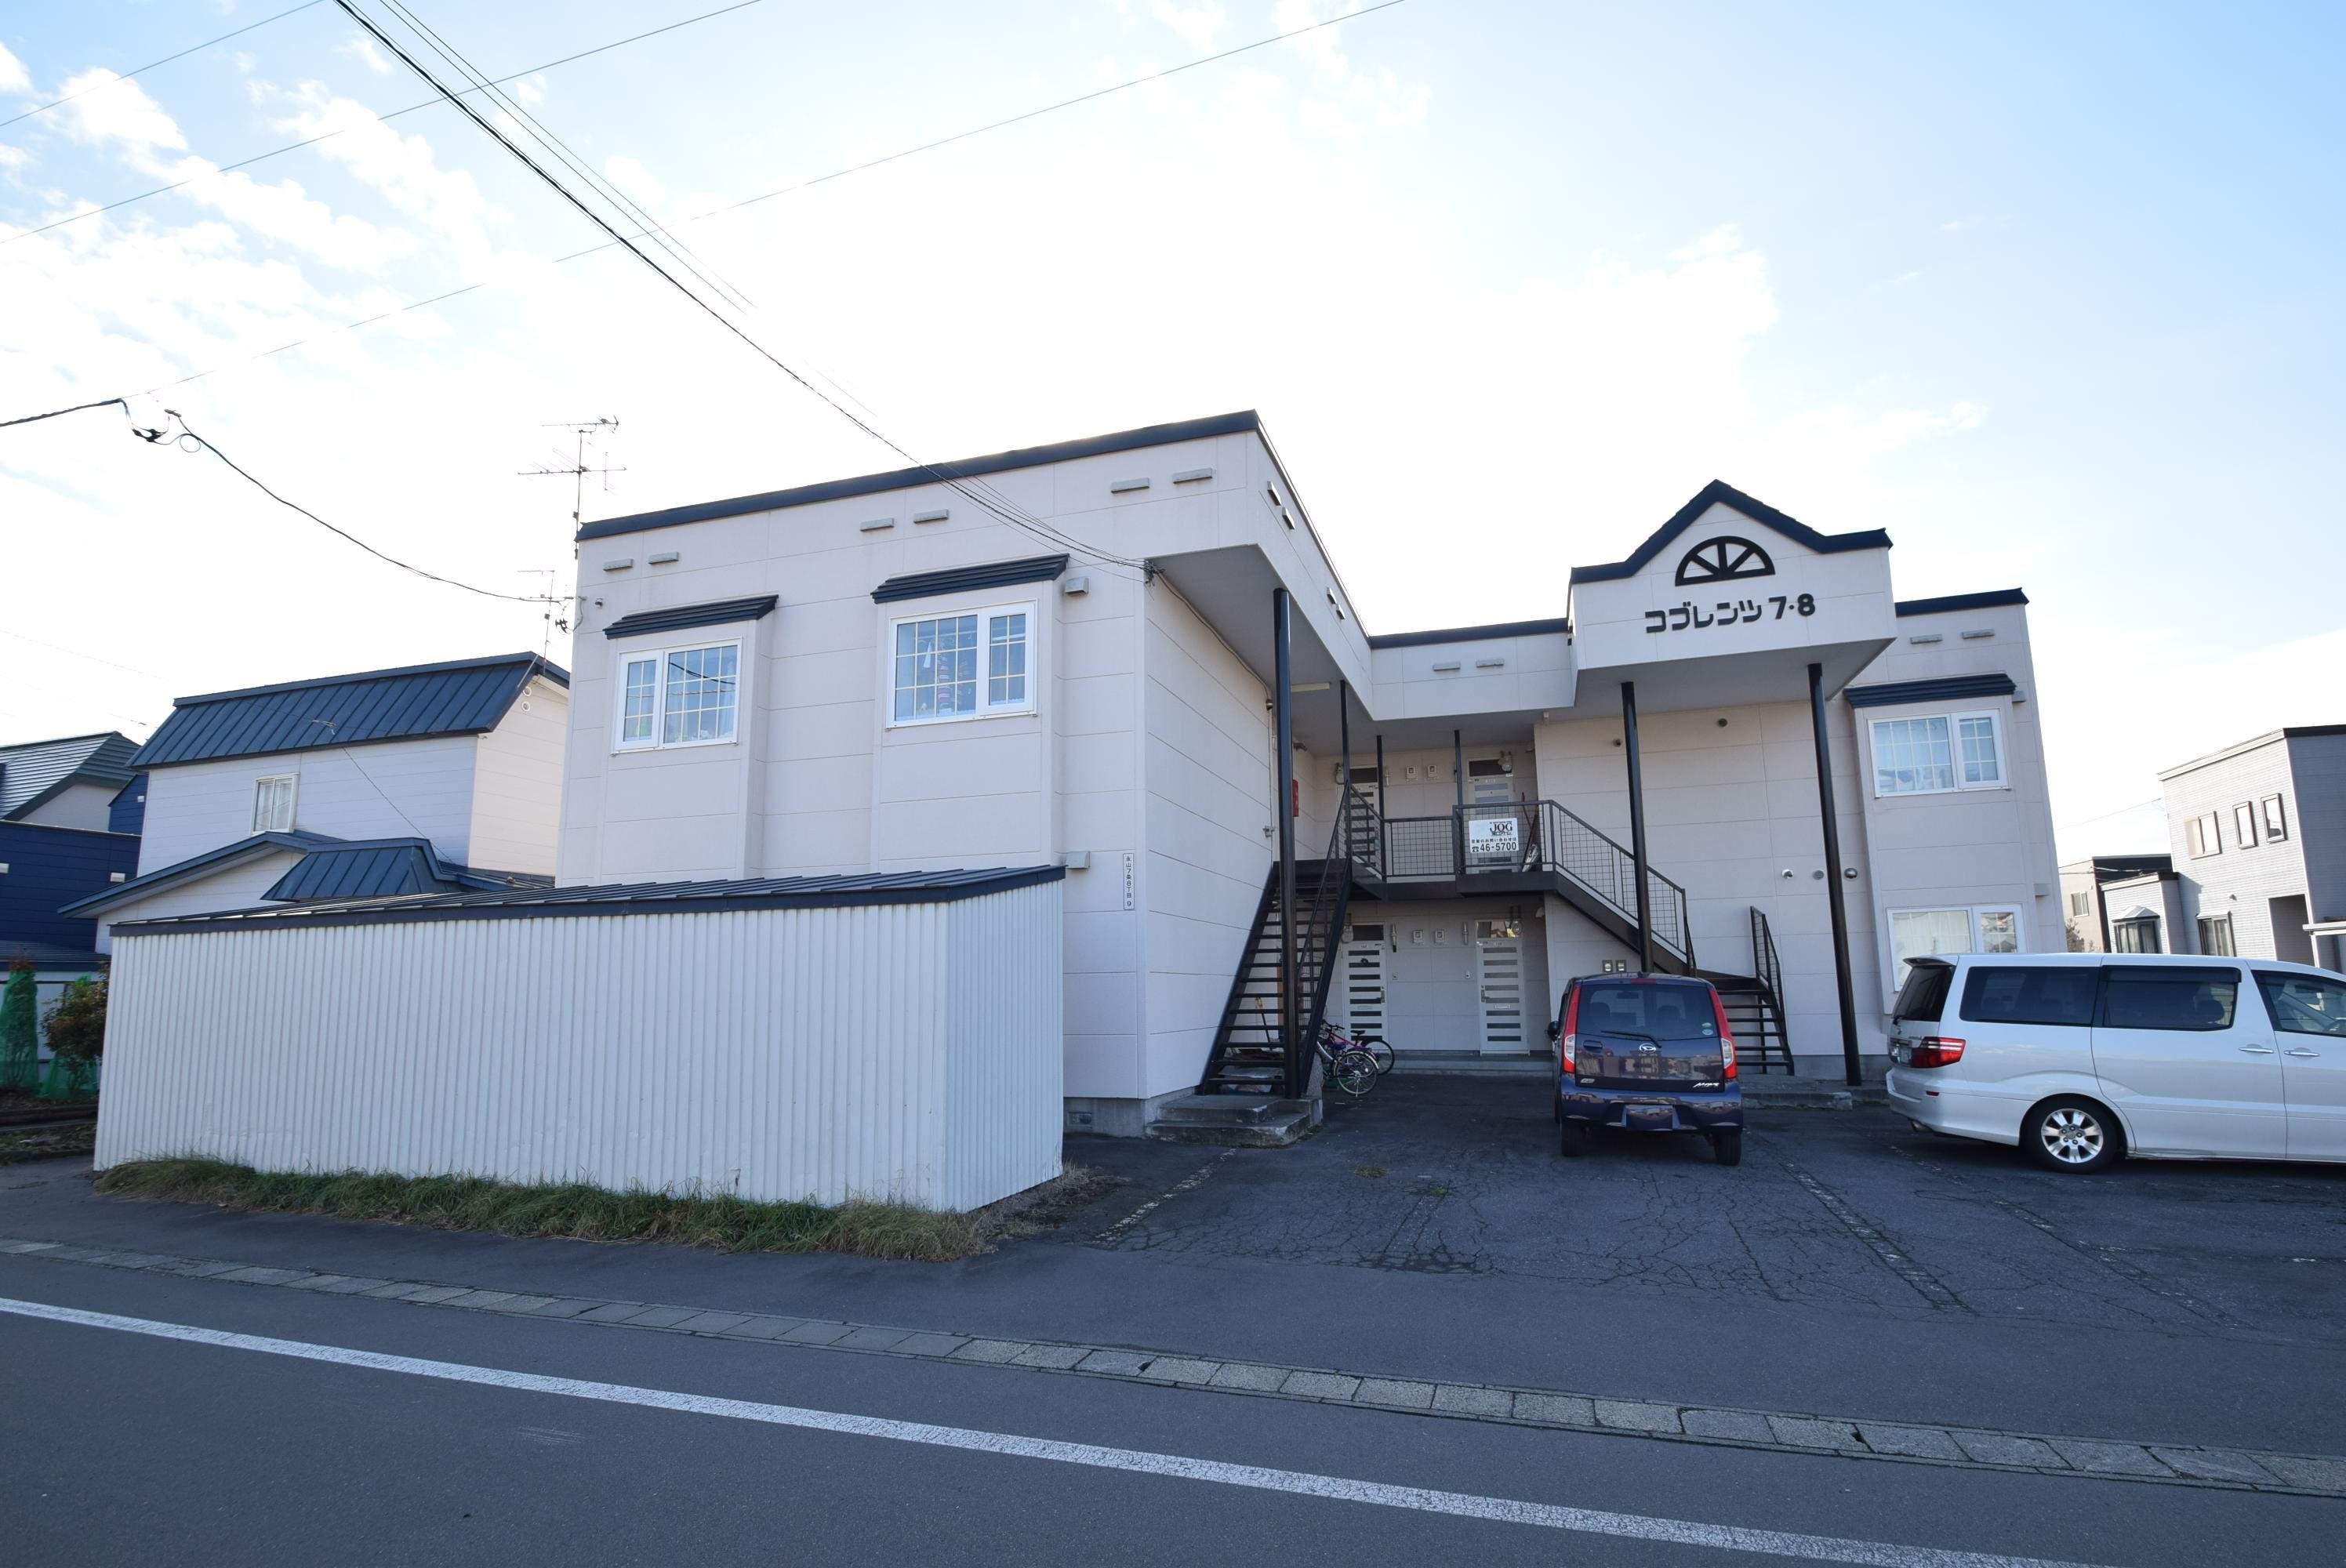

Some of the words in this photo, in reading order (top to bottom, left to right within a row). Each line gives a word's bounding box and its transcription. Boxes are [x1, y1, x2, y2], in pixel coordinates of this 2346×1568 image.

[1645, 600, 1762, 633] コブレンツ
[1490, 823, 1513, 832] JOG
[1480, 842, 1516, 851] 46-5700
